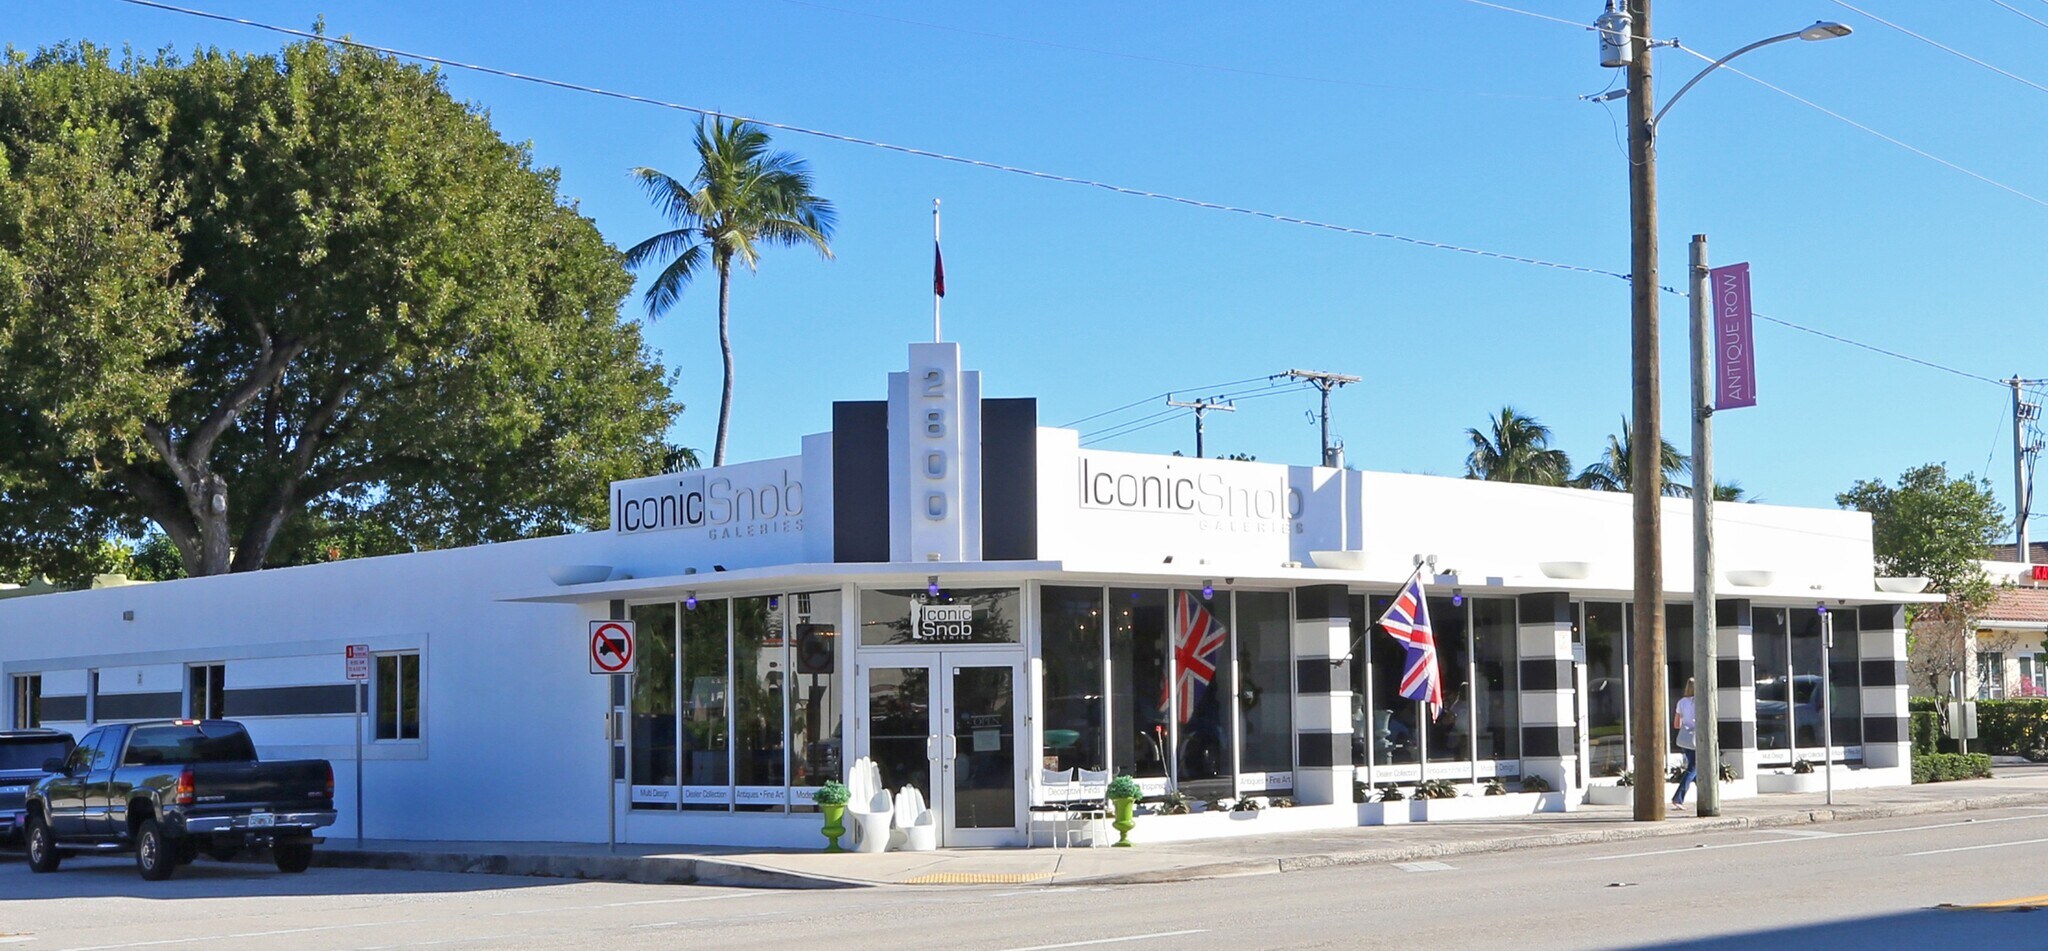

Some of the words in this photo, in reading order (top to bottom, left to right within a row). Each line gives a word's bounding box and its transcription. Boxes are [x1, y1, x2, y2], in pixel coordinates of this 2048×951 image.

[1723, 274, 1738, 318] ROW
[1725, 322, 1742, 400] ANTIQUE
[922, 367, 947, 521] 2800
[1084, 458, 1194, 510] Iconic
[1197, 472, 1304, 520] Snob
[618, 481, 702, 532] Iconic
[709, 469, 804, 525] Snob
[709, 519, 804, 541] GALERIES
[2035, 566, 2048, 580] KA
[923, 605, 971, 621] Iconic
[922, 621, 972, 636] Snob
[640, 789, 652, 797] Multi
[653, 789, 670, 799] Design
[685, 789, 702, 798] Dealer
[703, 789, 727, 798] Collection
[737, 790, 759, 799] Antiques
[763, 790, 774, 798] Fine
[775, 790, 785, 798] Art
